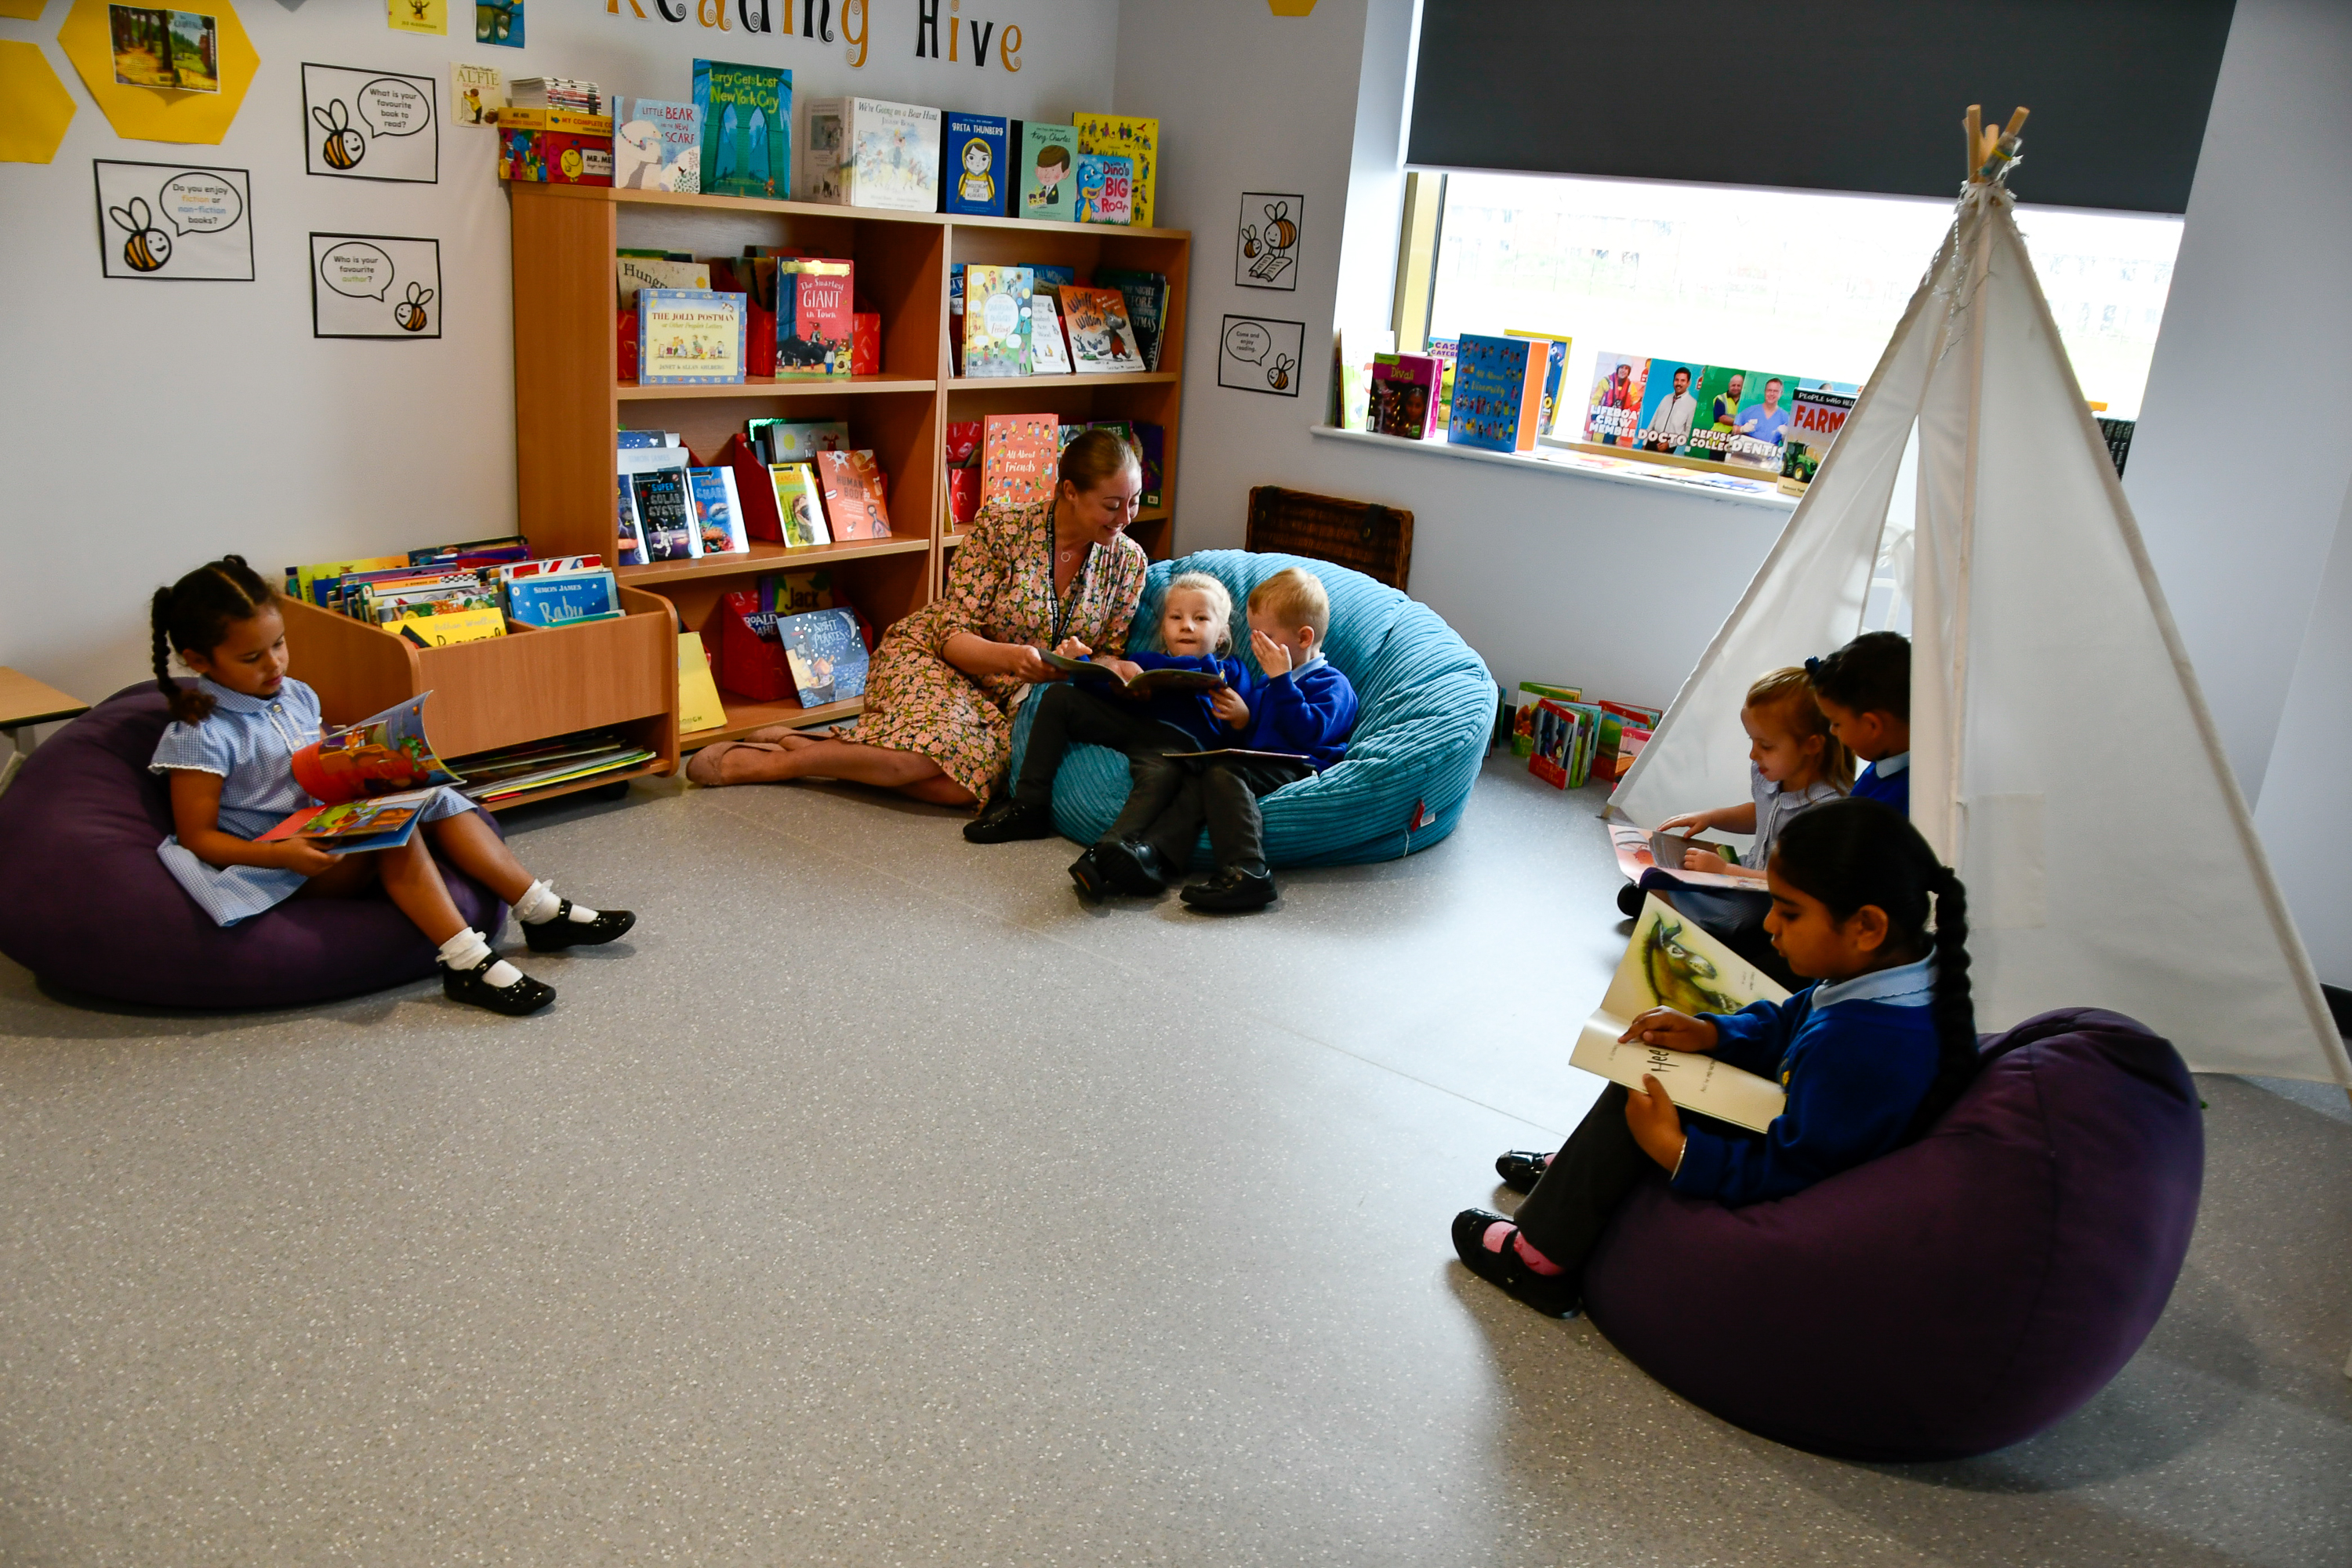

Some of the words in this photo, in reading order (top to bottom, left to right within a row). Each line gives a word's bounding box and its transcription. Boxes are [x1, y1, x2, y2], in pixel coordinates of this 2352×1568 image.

[606, 0, 869, 68] ading
[916, 0, 1022, 72] Hive
[456, 69, 499, 86] ALFIE
[710, 68, 733, 87] Larry
[734, 72, 756, 85] Gets
[757, 74, 779, 87] Lost
[369, 88, 390, 96] What
[377, 99, 412, 109] favourite
[710, 85, 735, 103] New
[735, 87, 757, 106] York
[757, 90, 779, 114] City
[642, 107, 663, 117] LITTLE
[665, 106, 695, 122] BEAR
[858, 101, 874, 112] We're
[875, 104, 893, 117] Going
[908, 108, 922, 118] Bear
[922, 110, 938, 121] Hunt
[573, 118, 603, 128] COMPLETE
[952, 122, 971, 132] GRETA
[973, 125, 1004, 136] THUNBERG
[665, 132, 695, 144] SCARF
[1031, 130, 1047, 143] King
[1048, 132, 1071, 143] Charles
[1102, 161, 1130, 176] Dino's
[205, 187, 228, 195] enjoy
[1105, 177, 1128, 198] BIG
[181, 194, 209, 203] fiction
[1102, 198, 1129, 212] Roar
[178, 205, 227, 214] non-fiction
[623, 263, 668, 289] Hungr
[800, 281, 813, 290] The
[815, 278, 844, 291] Smartest
[803, 289, 842, 308] GIANT
[652, 312, 670, 321] THE
[672, 313, 695, 321] JOLLY
[698, 313, 735, 321] POSTMAN
[815, 308, 837, 318] Town
[1435, 342, 1458, 350] CAS
[1391, 366, 1414, 380] Divali
[1798, 391, 1824, 402] PEOPLE
[1842, 398, 1856, 407] HEL
[1590, 405, 1639, 420] LIFEBOA
[1794, 404, 1848, 434] FARM
[1595, 415, 1633, 428] CREW
[1588, 422, 1636, 438] MEMBER
[1638, 428, 1688, 446] DOCTO
[1006, 449, 1016, 459] All
[1017, 449, 1036, 459] About
[1731, 440, 1784, 458] DENTIS
[1005, 460, 1036, 473] Friends
[651, 482, 674, 492] SUPER
[837, 474, 864, 488] HUMAN
[650, 492, 681, 505] SOLAR
[844, 487, 864, 499] BODY
[785, 587, 819, 610] Jack
[743, 613, 778, 627] ROALD
[812, 619, 837, 632] NIGHT
[811, 630, 846, 649] PIRATES
[1646, 1049, 1680, 1073] Hee
